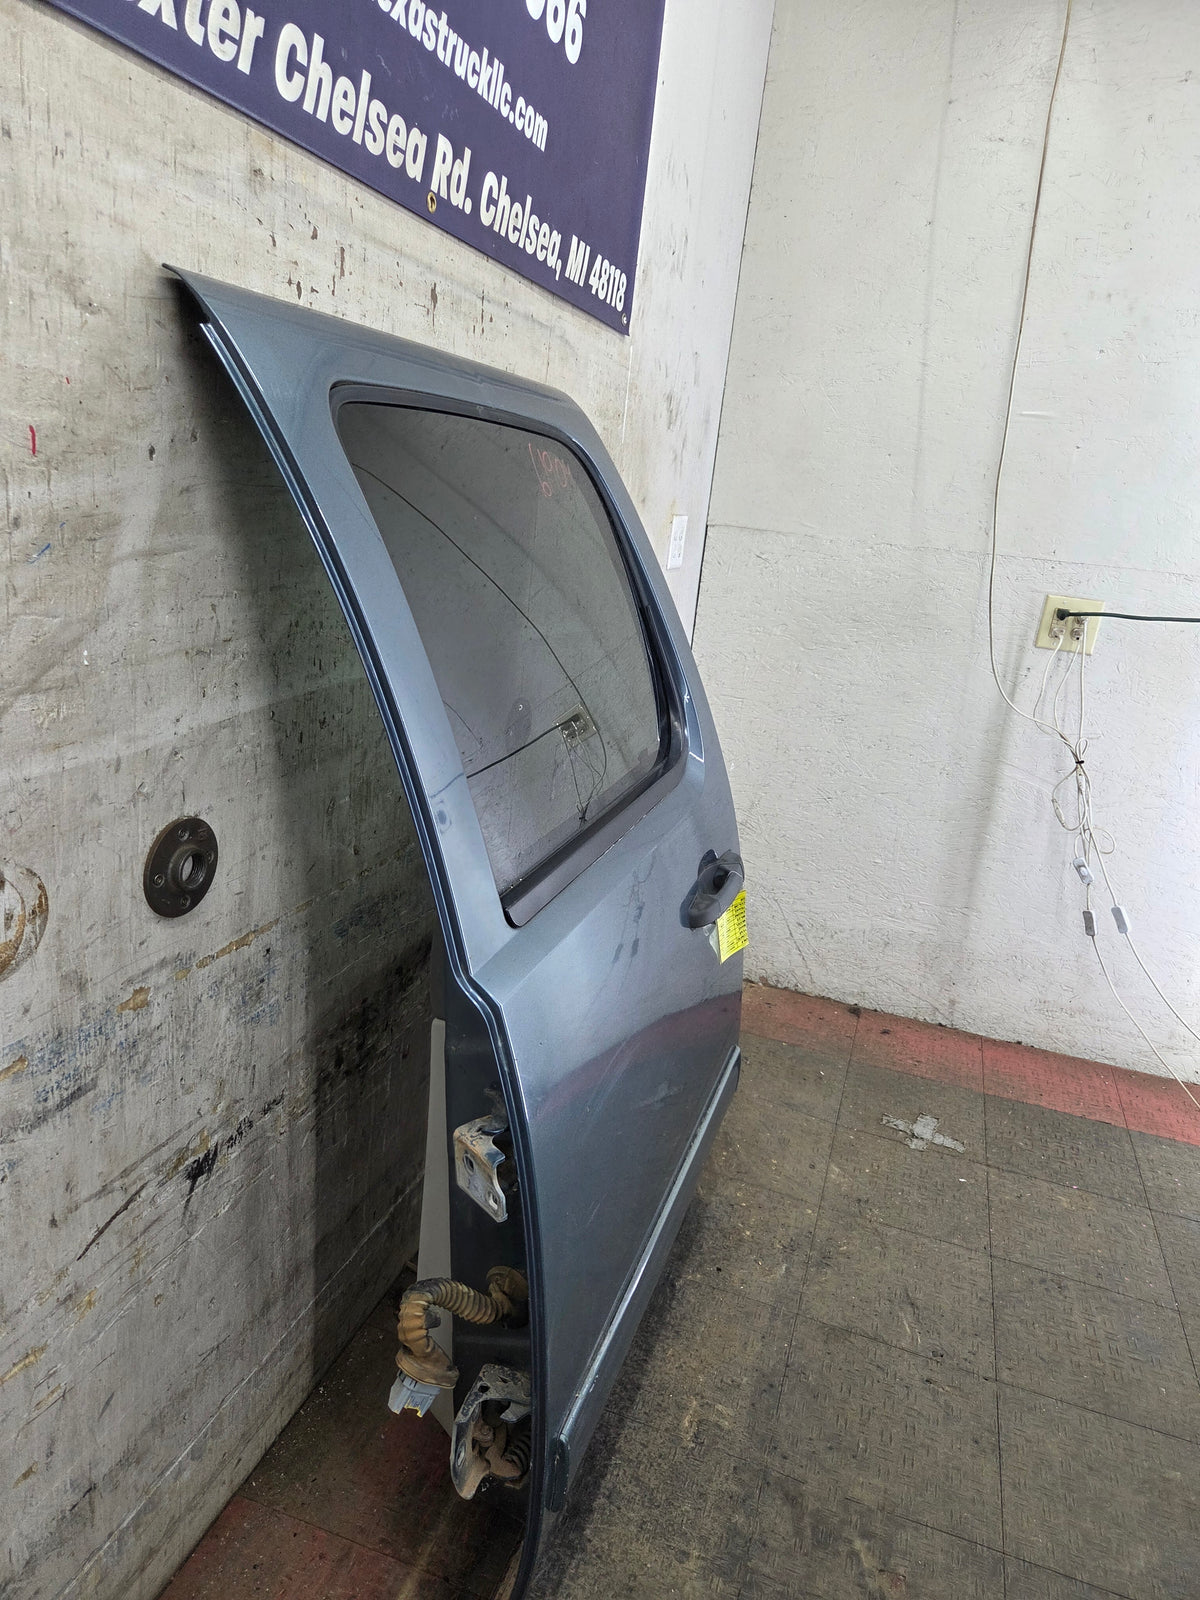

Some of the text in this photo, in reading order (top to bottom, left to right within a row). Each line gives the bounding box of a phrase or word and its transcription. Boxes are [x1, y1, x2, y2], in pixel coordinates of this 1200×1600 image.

[371, 0, 549, 152] xastruckllc.com
[525, 0, 587, 65] 66
[126, 0, 627, 312] ter Chelsea Rd. Chelsea, MI 48118
